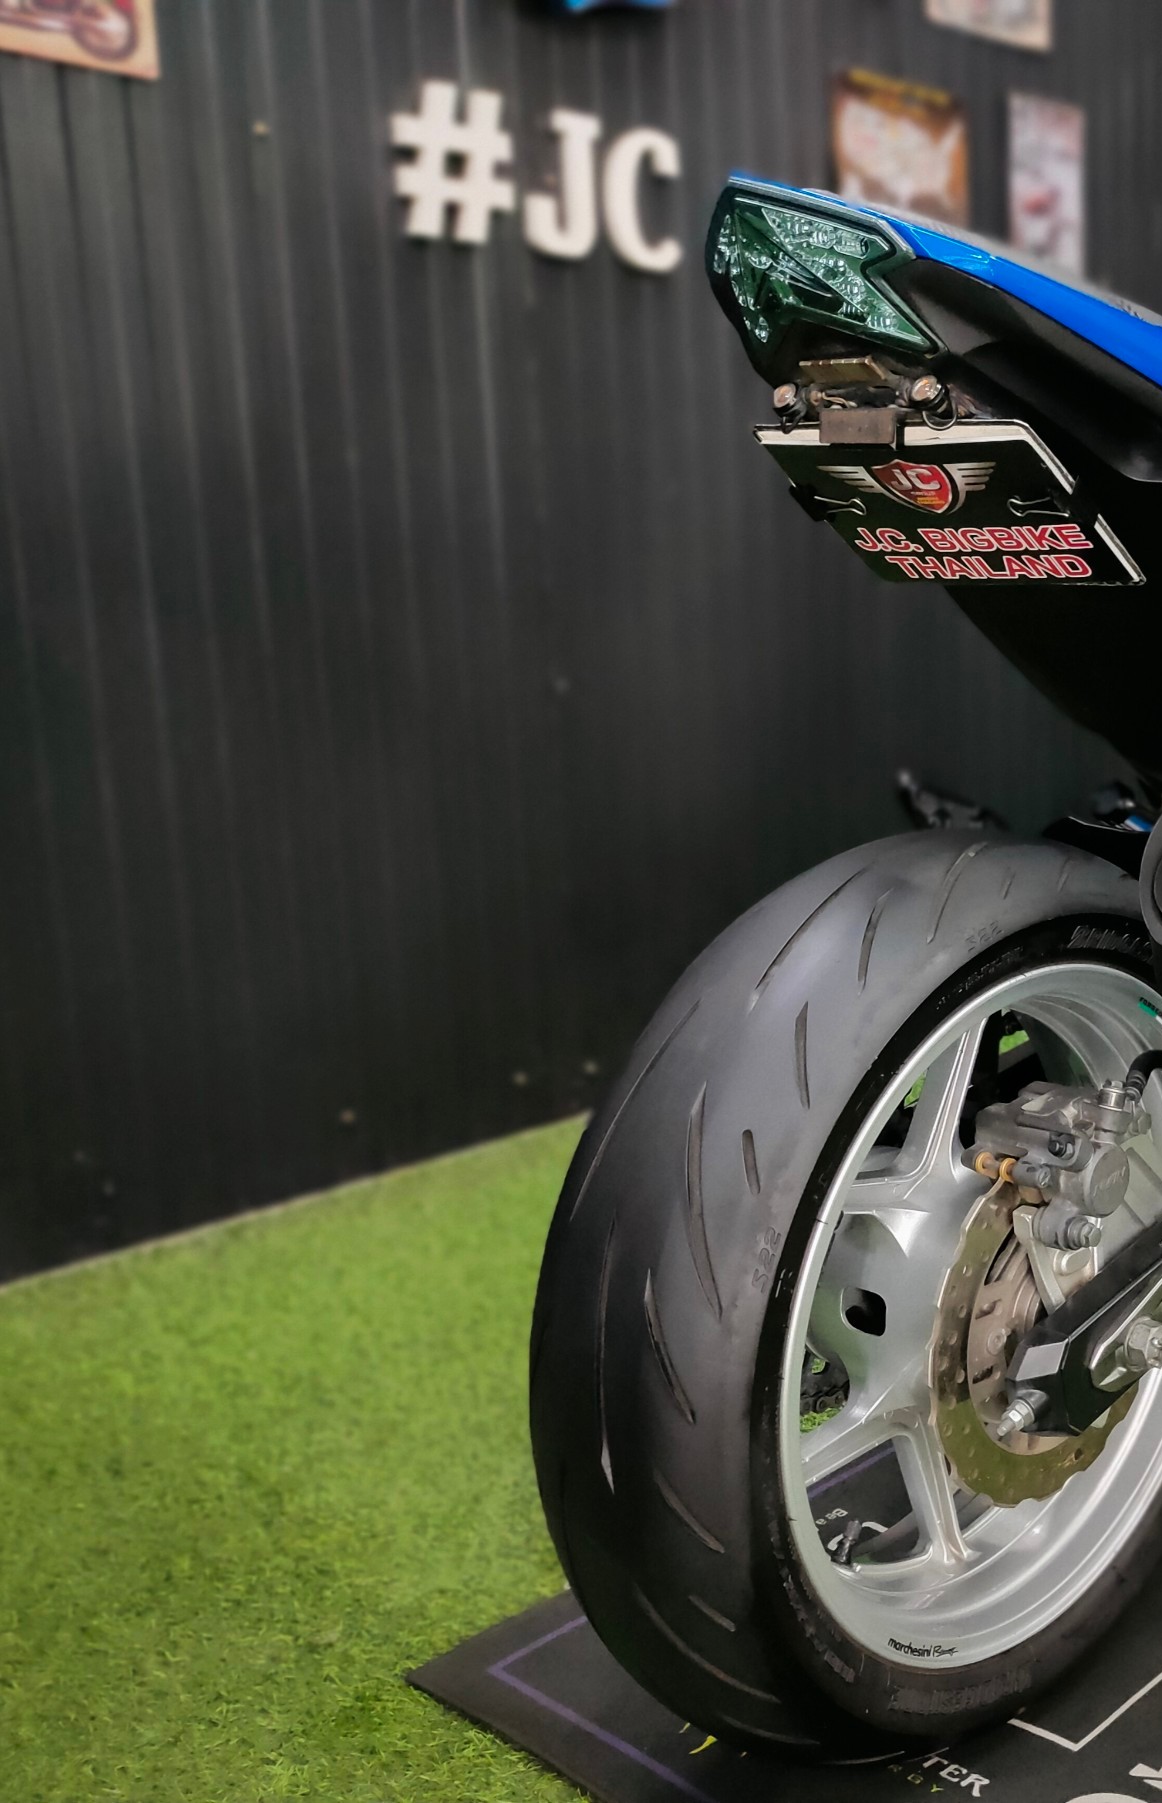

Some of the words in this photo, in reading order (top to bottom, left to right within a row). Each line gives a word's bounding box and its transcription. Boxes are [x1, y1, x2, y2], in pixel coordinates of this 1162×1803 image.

[390, 80, 683, 273] #JC
[891, 468, 941, 491] JC
[855, 527, 923, 552] J.C.
[918, 524, 1093, 552] BIGBIKE
[886, 554, 1092, 579] THAILAND
[887, 1637, 932, 1658] marchesini
